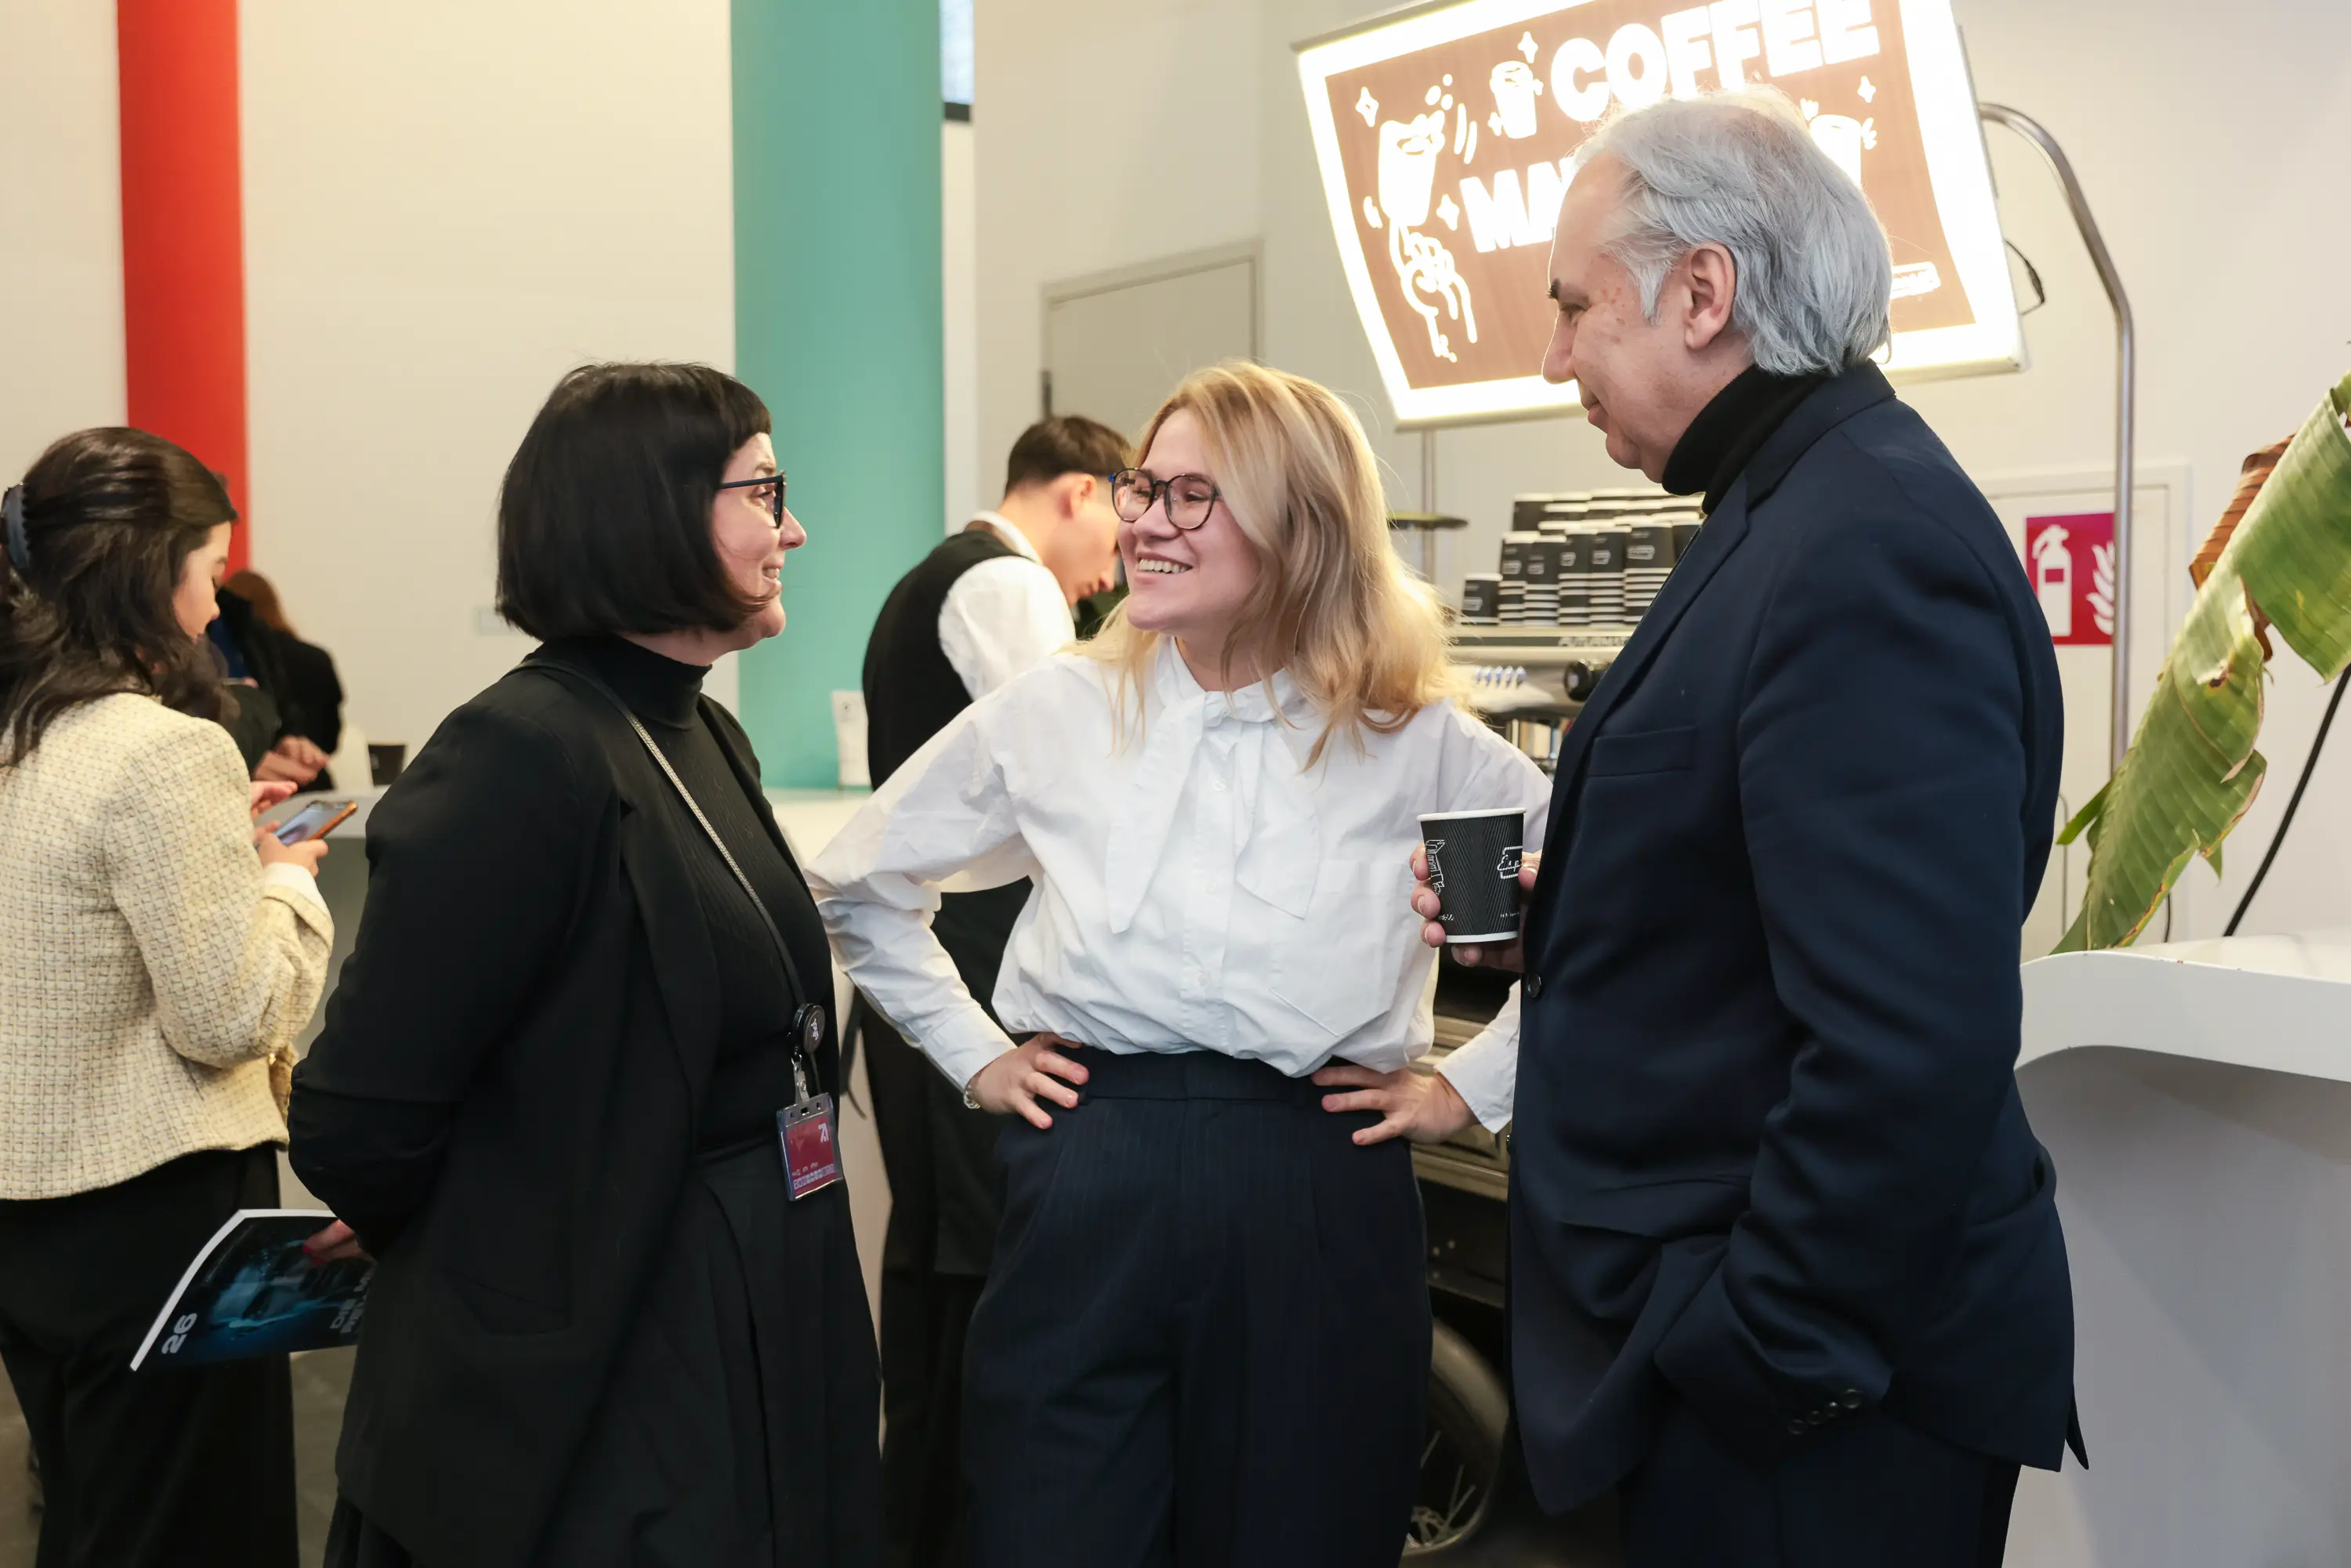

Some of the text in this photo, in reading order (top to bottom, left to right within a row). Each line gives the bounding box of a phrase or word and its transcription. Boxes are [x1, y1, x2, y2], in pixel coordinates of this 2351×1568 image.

[1550, 0, 1881, 121] COFFEE
[1459, 155, 1578, 253] MA
[1497, 854, 1522, 872] Esp
[161, 1313, 197, 1354] 26
